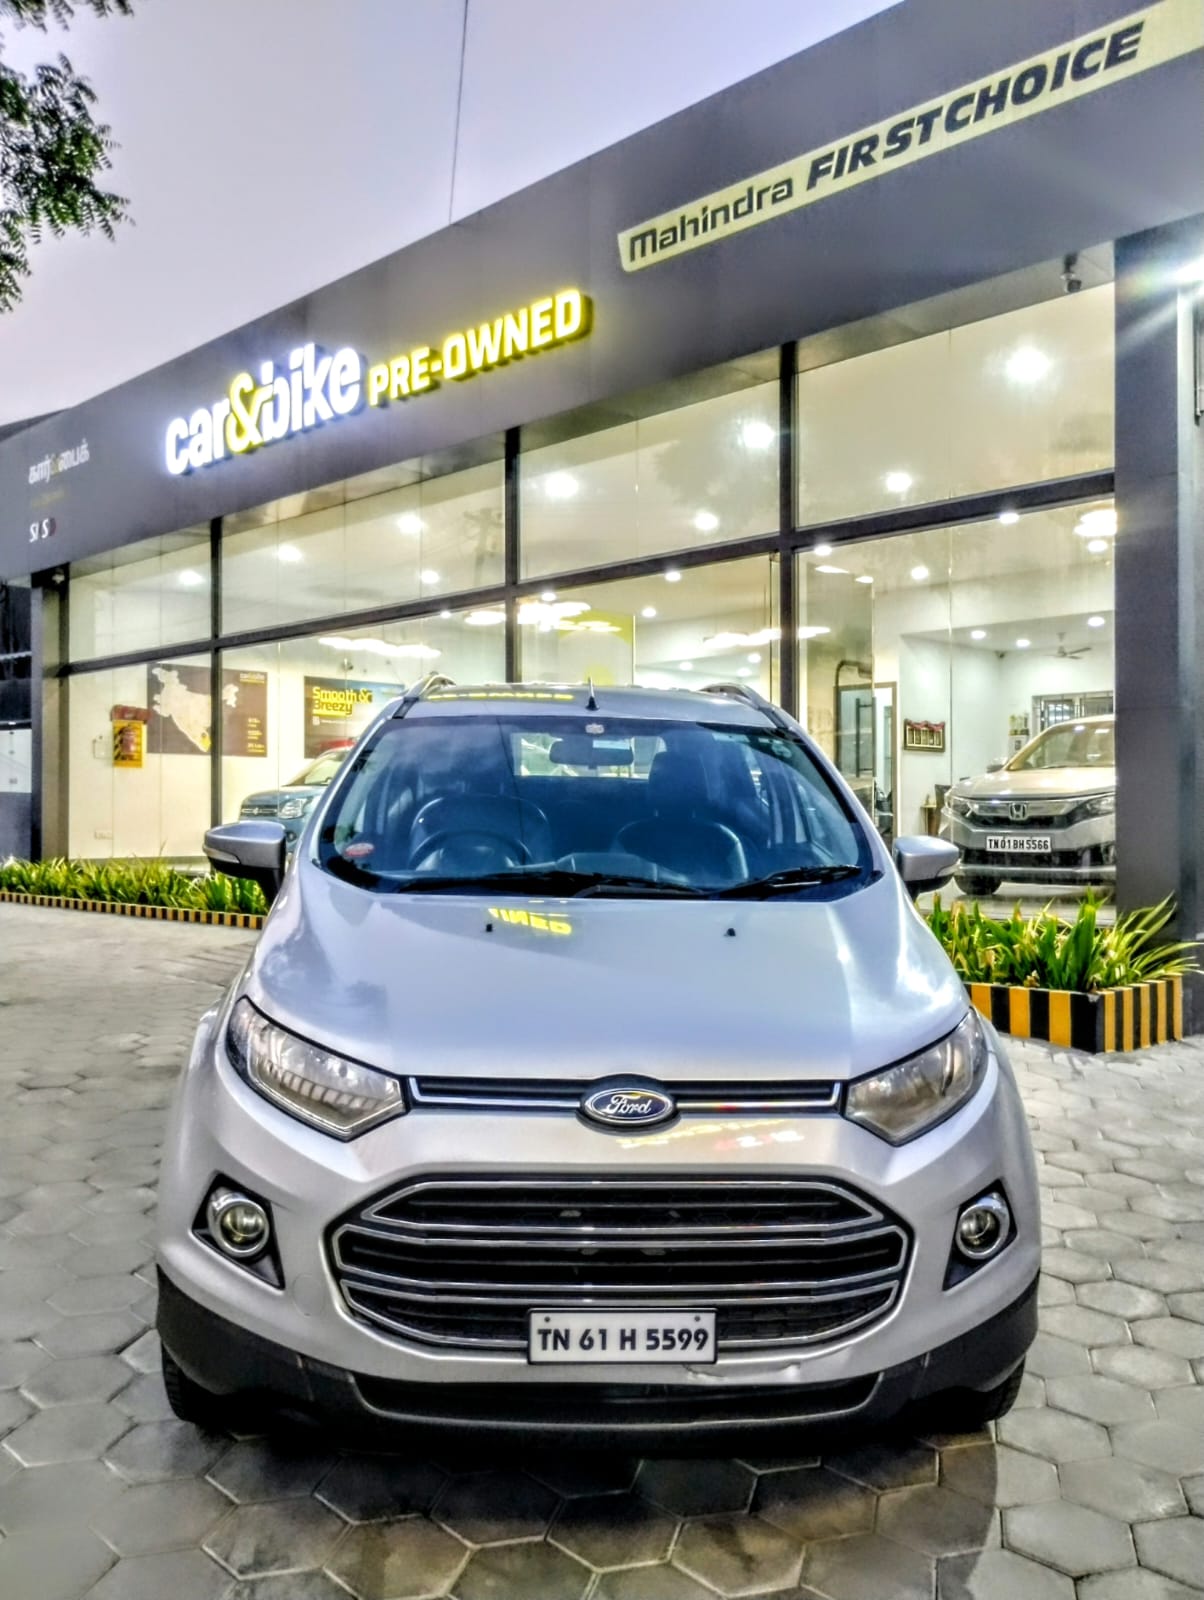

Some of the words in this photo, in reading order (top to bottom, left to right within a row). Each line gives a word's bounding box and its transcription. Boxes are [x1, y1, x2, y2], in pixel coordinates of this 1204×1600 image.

[629, 177, 794, 264] Mahindra
[806, 20, 1146, 192] FIRSTCHOICE
[165, 342, 361, 475] car&bike
[368, 288, 583, 407] PRE-OWNED
[312, 686, 357, 703] Smooth
[358, 687, 374, 704] &
[312, 699, 352, 717] Breezy
[604, 1093, 652, 1115] Ford
[537, 1328, 570, 1351] TN
[578, 1328, 607, 1351] 61
[619, 1328, 637, 1351] H
[646, 1328, 709, 1351] 5599
